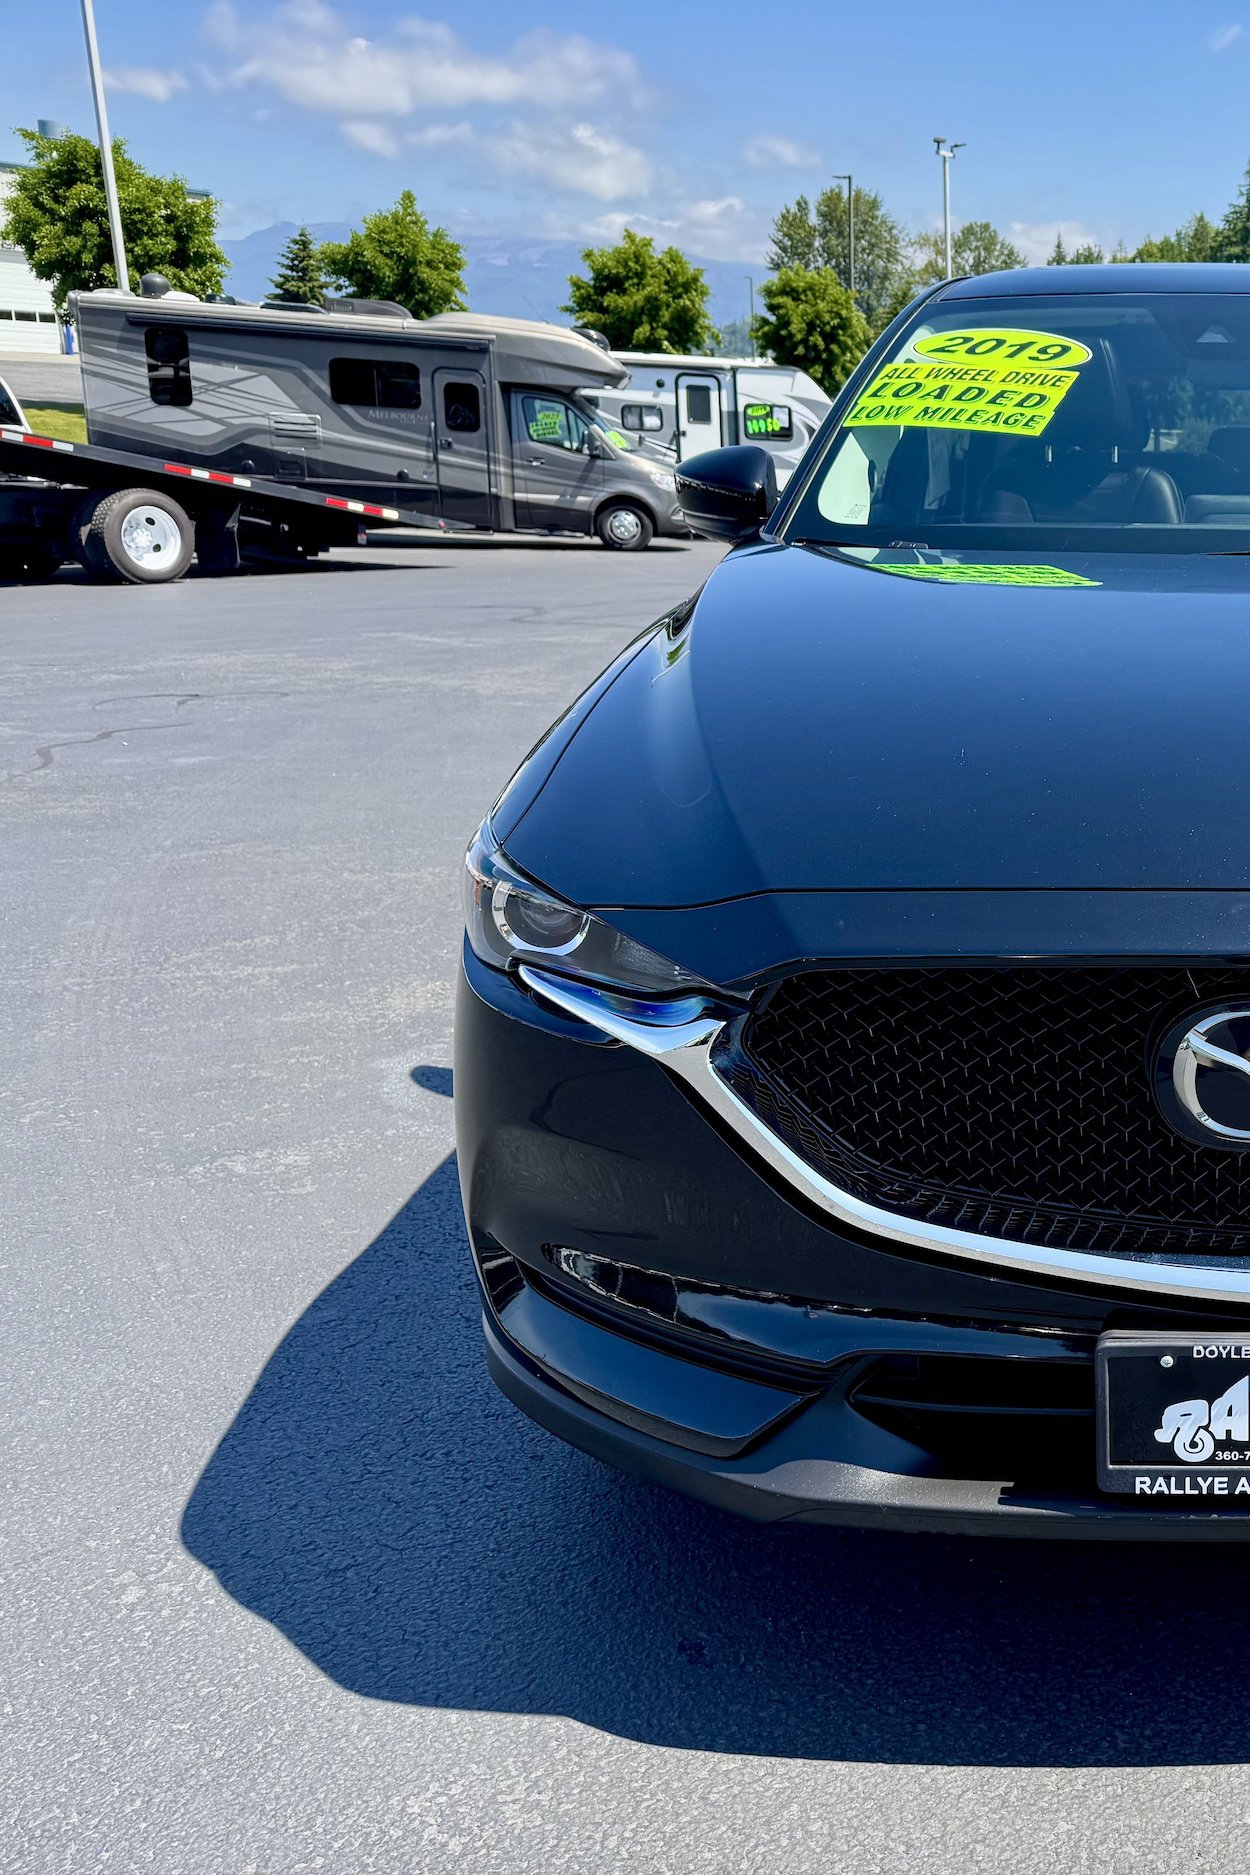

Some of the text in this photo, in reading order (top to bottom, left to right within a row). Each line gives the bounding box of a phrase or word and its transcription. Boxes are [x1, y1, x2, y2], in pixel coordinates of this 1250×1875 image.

[926, 336, 1072, 362] 2019
[880, 367, 1070, 388] ALL WHEEL DRIVE
[867, 382, 1051, 410] LOADED
[850, 405, 1046, 430] LOW MILEAGE
[1135, 1476, 1229, 1495] RALLYE
